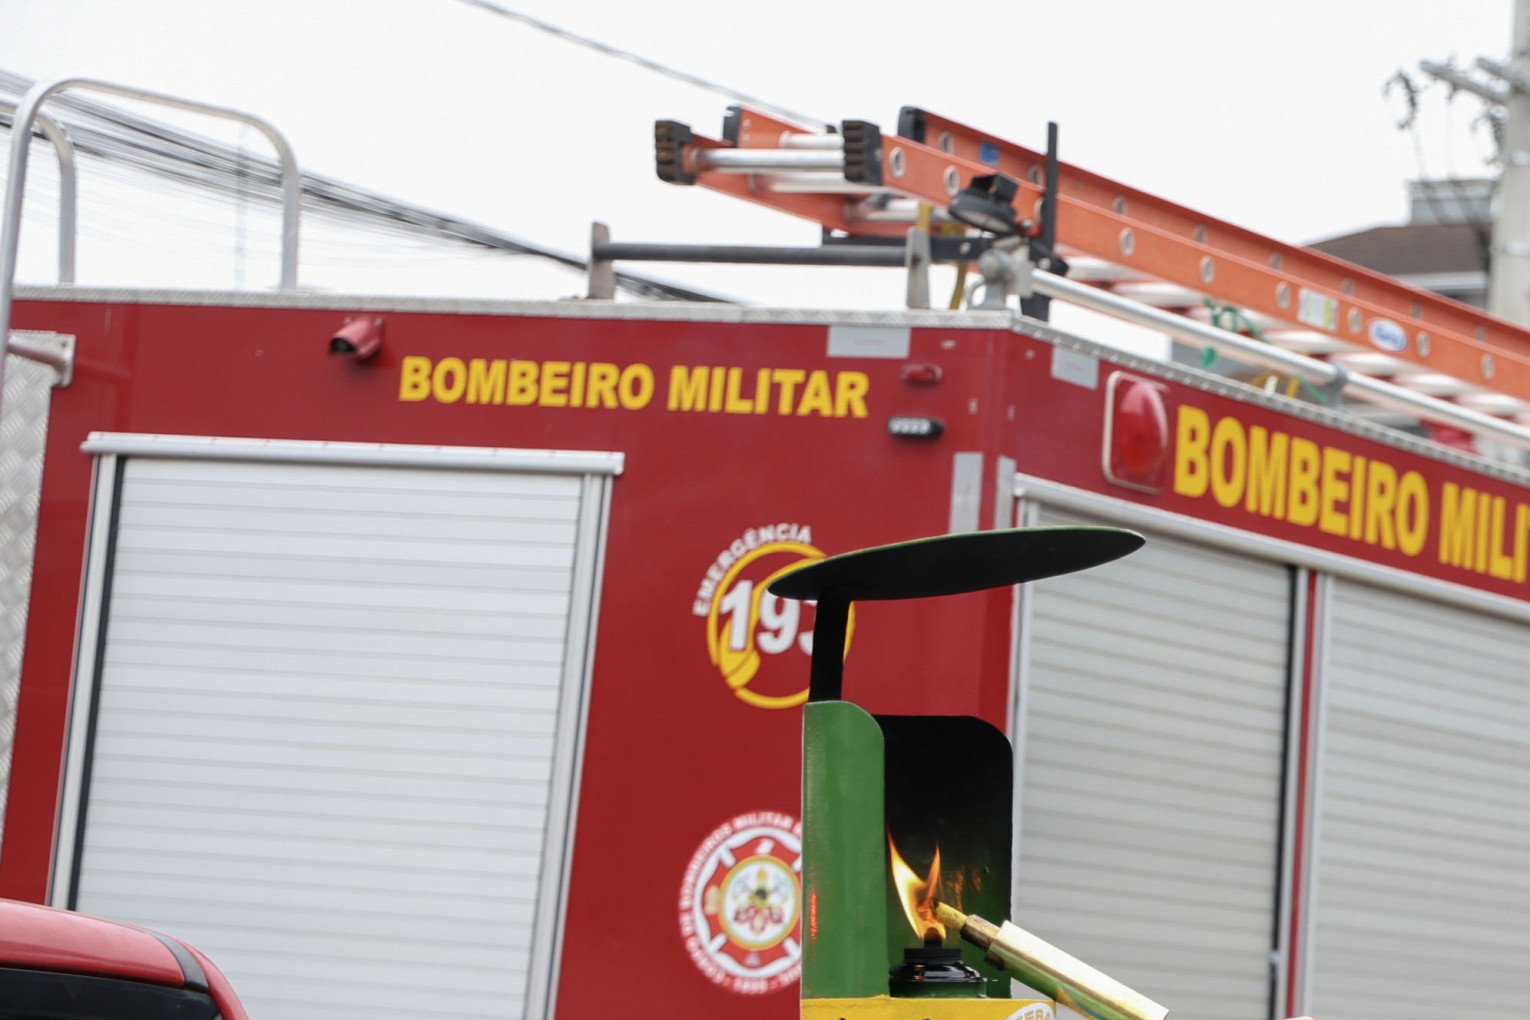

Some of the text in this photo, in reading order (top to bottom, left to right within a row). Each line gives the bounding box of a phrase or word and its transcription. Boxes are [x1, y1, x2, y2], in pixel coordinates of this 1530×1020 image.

[399, 356, 870, 419] BOMBEIRO MILITAR
[1173, 403, 1430, 558] BOMBEIRO
